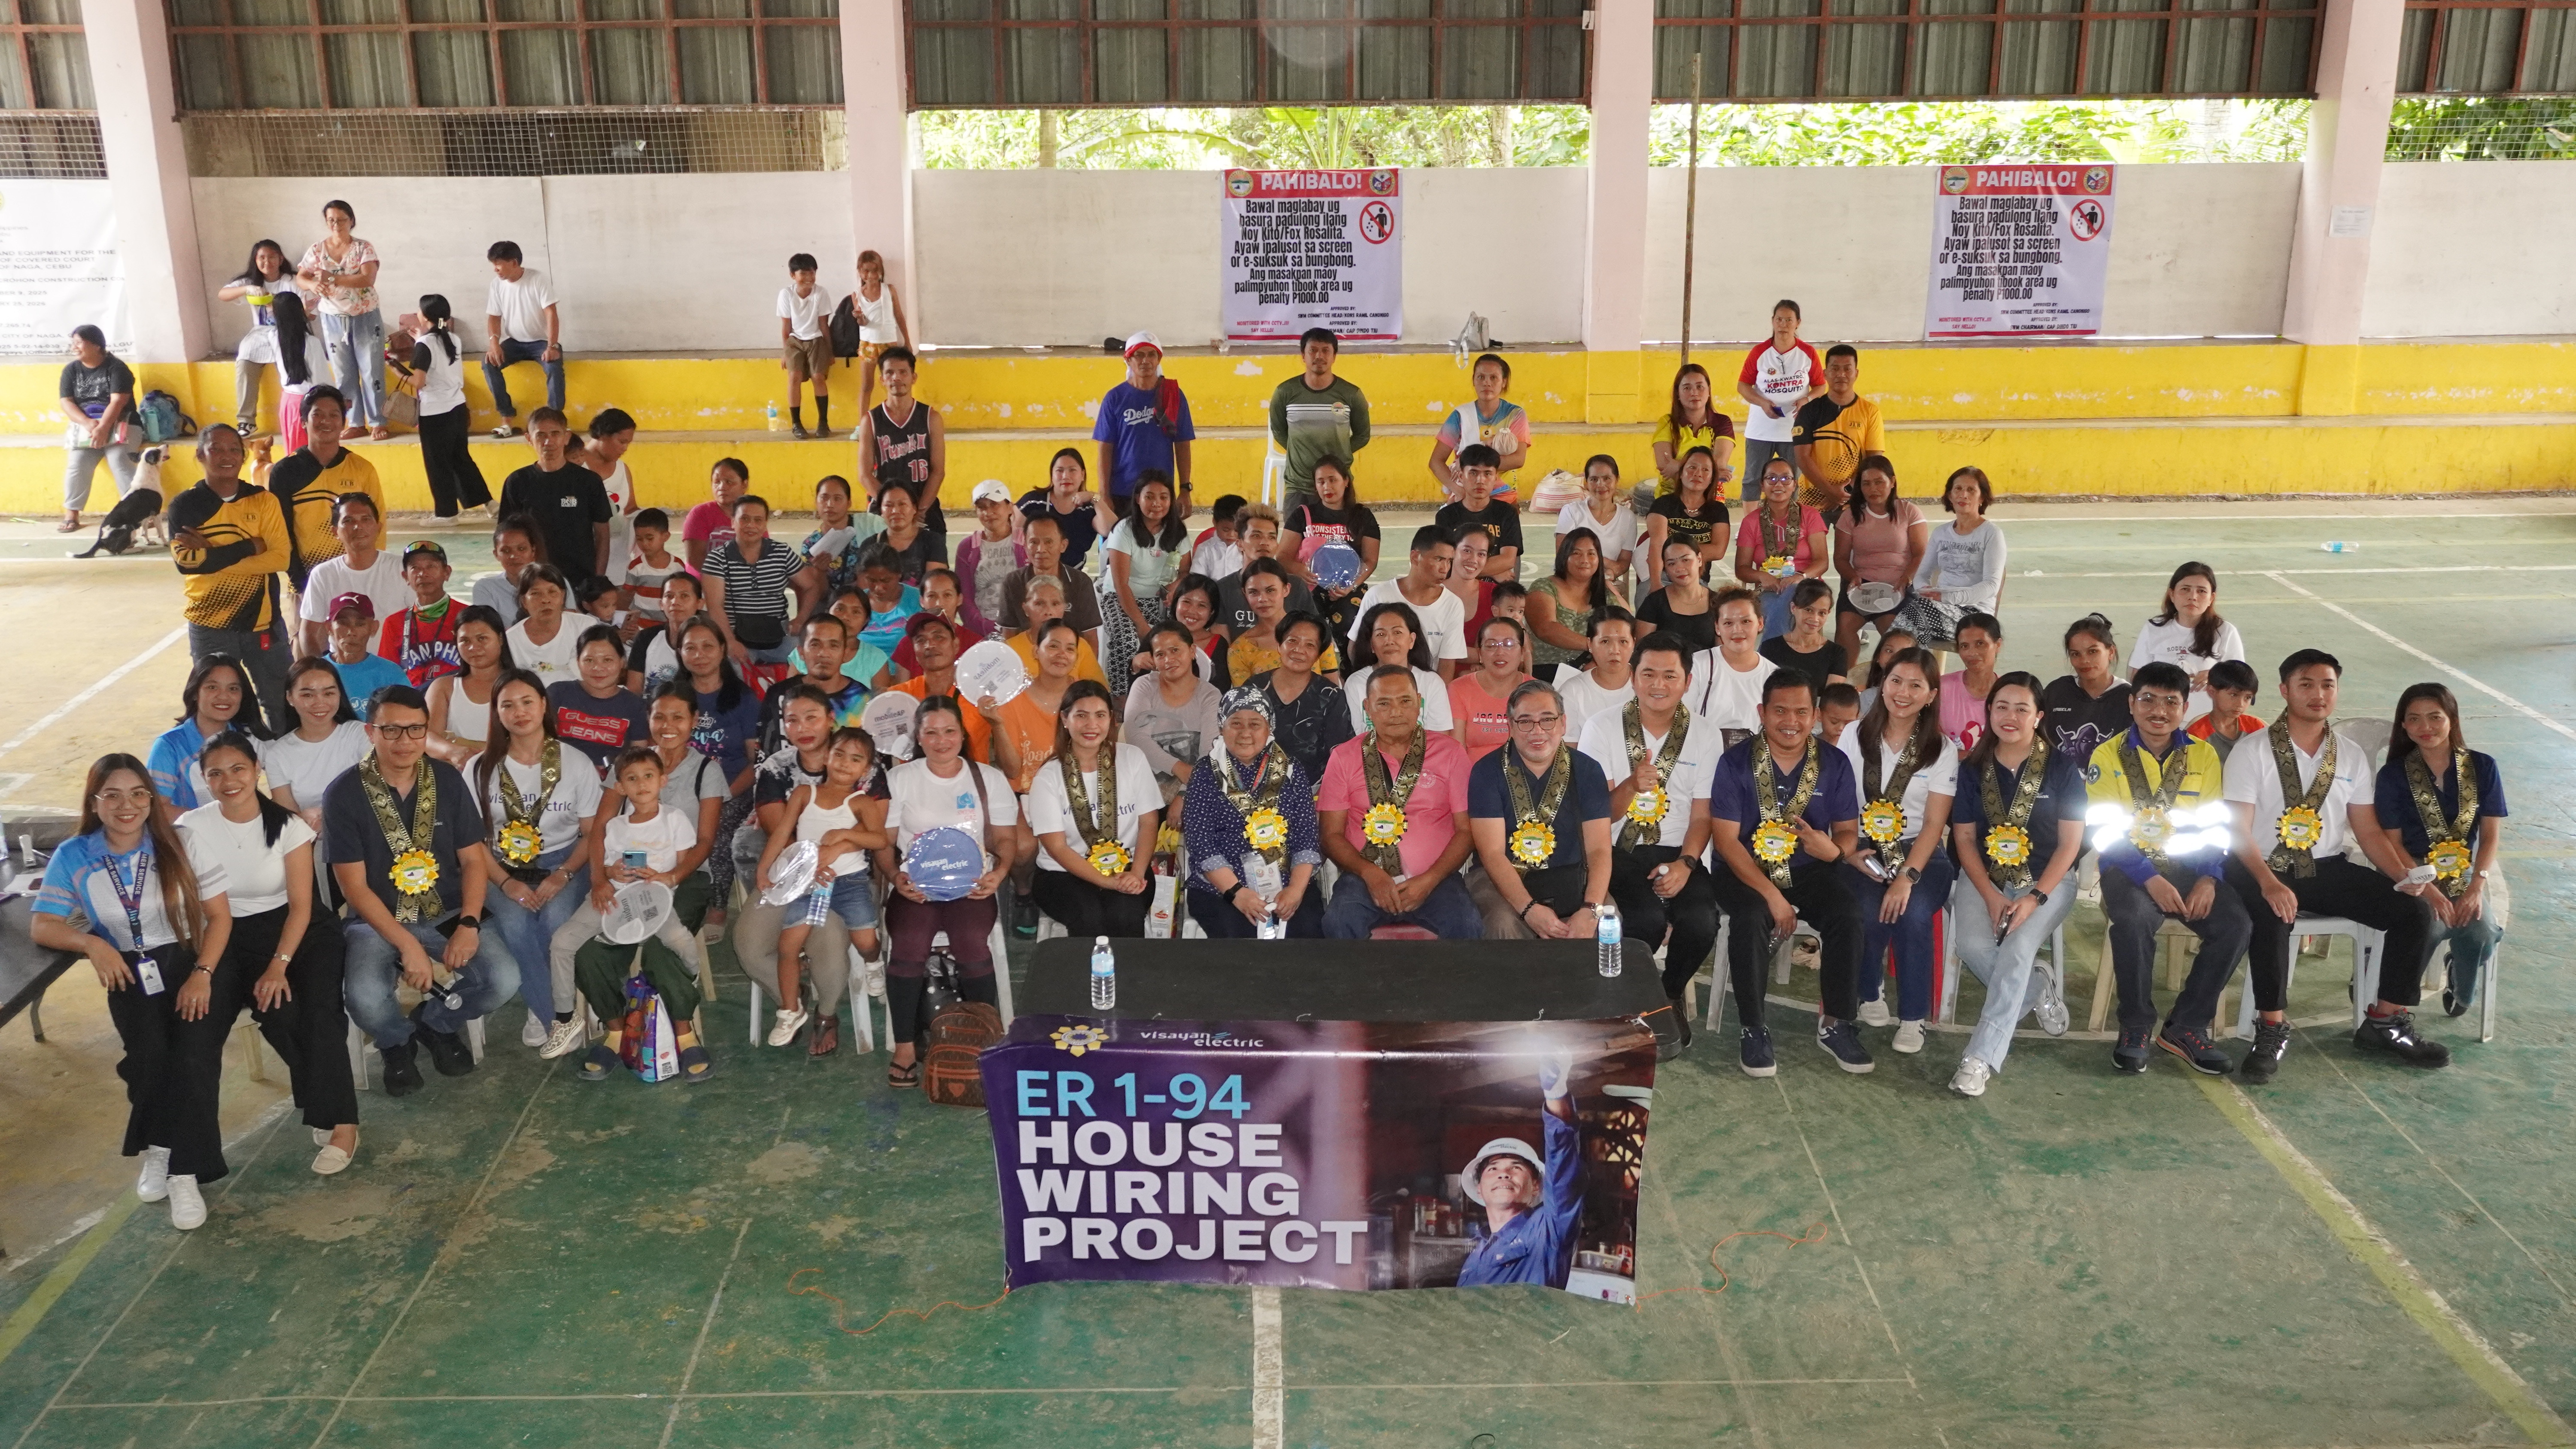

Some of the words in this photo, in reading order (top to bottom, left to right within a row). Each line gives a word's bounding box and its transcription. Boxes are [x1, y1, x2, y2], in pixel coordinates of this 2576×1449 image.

[1261, 173, 1362, 190] PAHIBALO!
[1977, 171, 2077, 187] PAHIBALO!
[1245, 200, 1274, 214] Bawal
[1278, 199, 1325, 214] maglabay
[1327, 200, 1340, 213] ug
[1959, 196, 1987, 210] Bawal
[1990, 196, 2038, 211] maglabay
[2041, 198, 2052, 210] ug
[1239, 213, 1272, 227] basura
[1276, 213, 1320, 228] padulong
[1323, 213, 1346, 228] ilang
[1951, 210, 1984, 224] basura
[1987, 210, 2031, 225] padulong
[2034, 210, 2058, 224] ilang
[1241, 227, 1258, 241] Noy
[1261, 225, 1301, 241] Kito/Fox
[1303, 225, 1345, 240] Rosalita.
[1952, 224, 1970, 238] Noy
[1973, 222, 2011, 237] Kito/Fox
[2013, 222, 2054, 236] Rosalita.
[1234, 241, 1260, 255] Ayaw
[1263, 240, 1301, 255] ipalusot
[1305, 242, 1315, 253] sa
[1318, 241, 1352, 253] screen
[1944, 237, 1969, 251] Ayaw
[1972, 237, 2010, 252] ipalusot
[2013, 238, 2024, 250] sa
[2027, 238, 2060, 250] screen
[1231, 256, 1241, 267] or
[1244, 255, 1289, 267] e-suksuk
[1291, 256, 1303, 267] sa
[1305, 253, 1356, 268] bungbong.
[1939, 252, 1950, 264] or
[1952, 251, 1996, 264] e-suksuk
[1999, 251, 2010, 263] sa
[2013, 250, 2063, 265] bungbong.
[1250, 268, 1265, 281] Ang
[1268, 268, 1311, 281] masakpan
[1314, 268, 1337, 280] maoy
[1956, 265, 1972, 277] Ang
[1975, 264, 2018, 277] masakpan
[2020, 265, 2043, 277] maoy
[1235, 280, 1289, 295] palimpyuhon
[1292, 280, 1318, 292] tibook
[1321, 281, 1339, 291] area
[1342, 281, 1353, 292] ug
[1940, 277, 1995, 290] palimpyuhon
[1997, 276, 2023, 288] tibook
[2026, 277, 2044, 288] area
[2046, 277, 2057, 289] ug
[1259, 292, 1290, 306] penalty
[1292, 292, 1329, 304] P1000.00
[1963, 289, 1994, 302] penalty
[1996, 288, 2033, 301] P1000.00
[1764, 374, 1803, 383] ALAS-KWATRO
[1767, 380, 1802, 389] KONTRA
[1765, 386, 1803, 394] MOSQUITO
[907, 459, 928, 482] 16
[565, 712, 621, 729] GUESS
[1473, 712, 1493, 723] JAG
[562, 725, 618, 744] JEANS
[920, 858, 948, 868] visayan
[942, 860, 969, 871] electric
[1140, 1031, 1210, 1041] visayan
[1194, 1036, 1264, 1047] electric
[1016, 1070, 1097, 1117] ER
[1114, 1072, 1251, 1119] 1-94
[1018, 1120, 1283, 1167] HOUSE
[1016, 1169, 1300, 1216] WIRING
[1023, 1217, 1368, 1265] PROJECT
